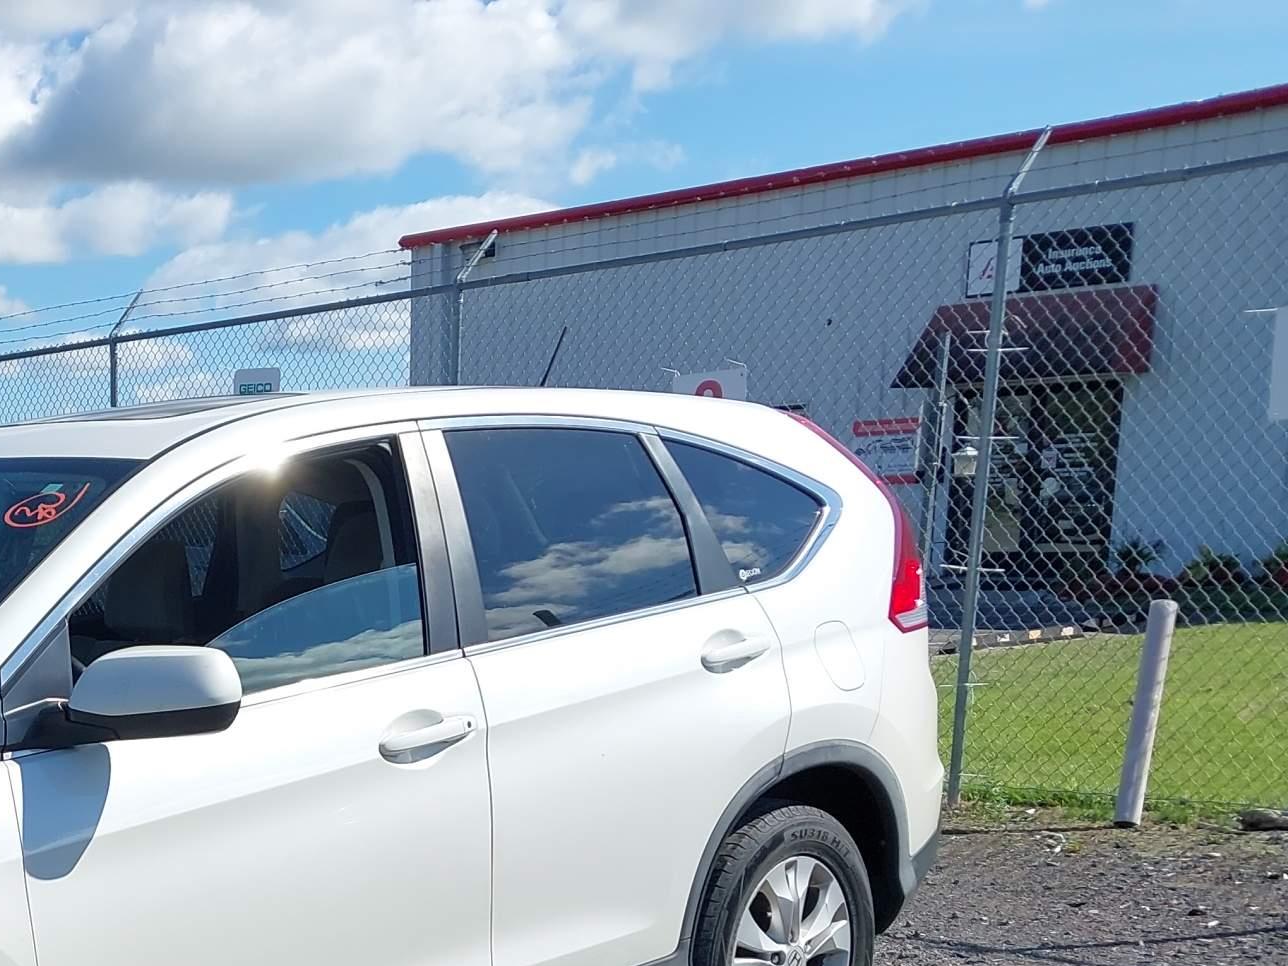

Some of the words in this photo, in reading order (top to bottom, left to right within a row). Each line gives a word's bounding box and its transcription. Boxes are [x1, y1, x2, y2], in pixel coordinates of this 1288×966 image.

[1047, 245, 1102, 260] Insurance
[1036, 262, 1062, 275] Auto
[1063, 257, 1113, 273] Auctions
[239, 382, 273, 395] GEICO
